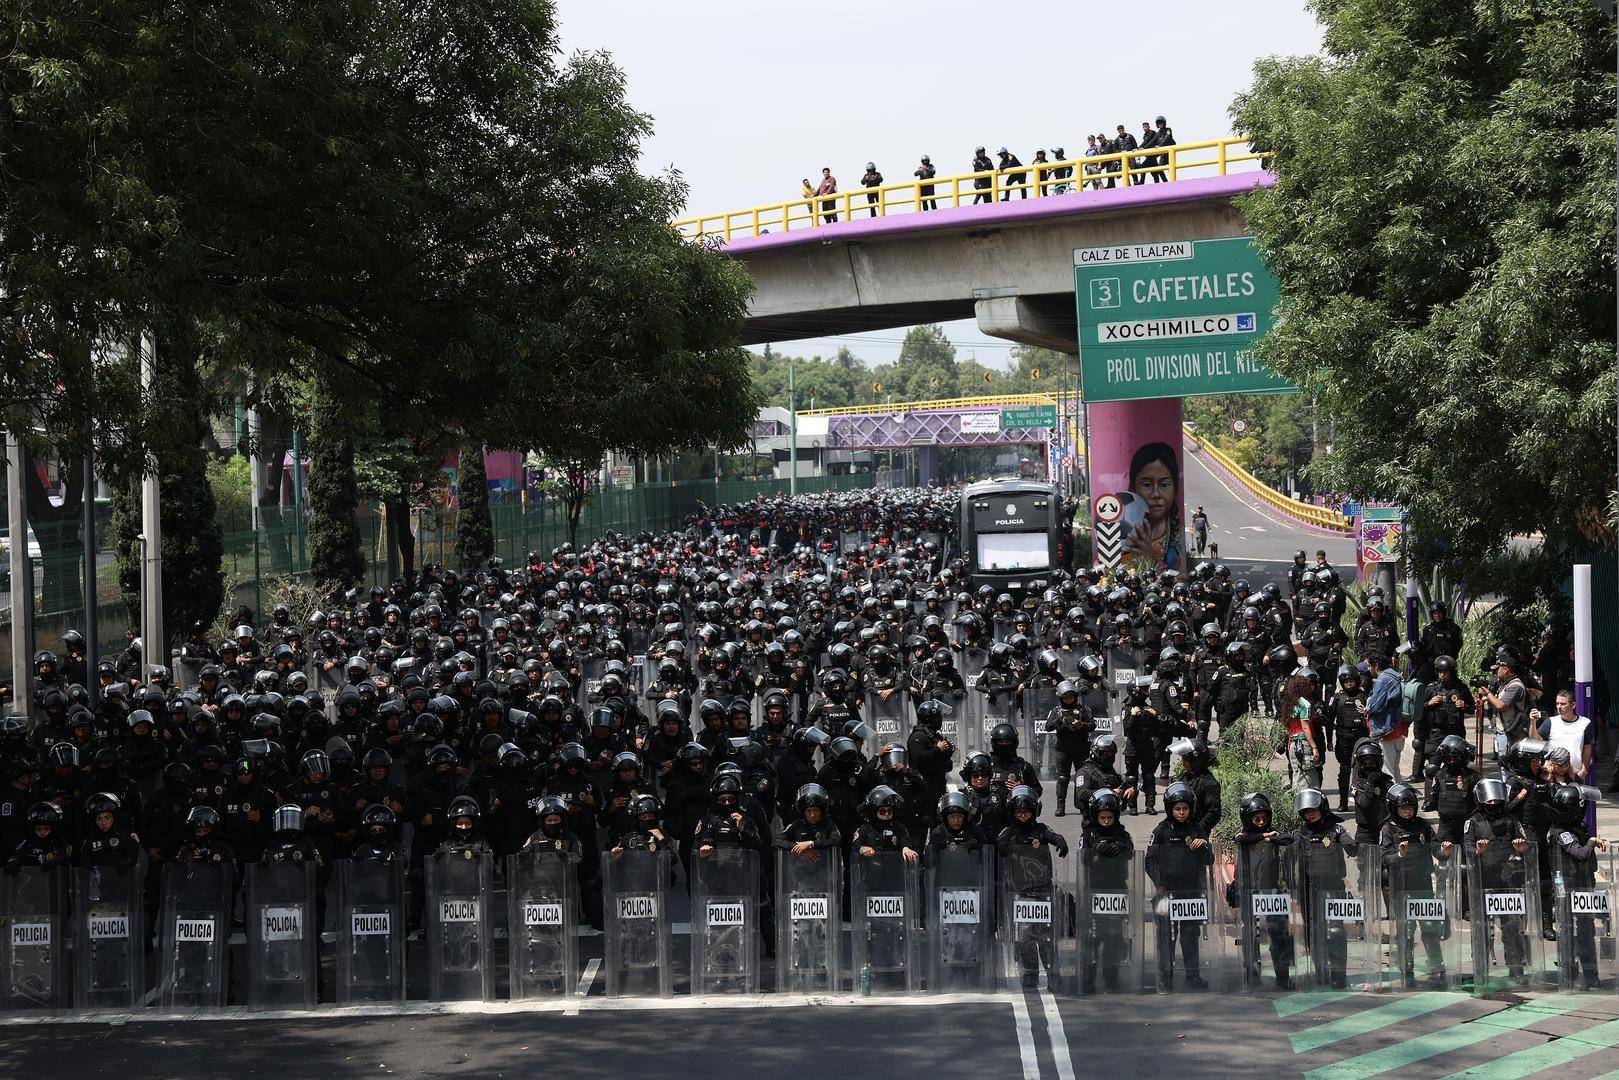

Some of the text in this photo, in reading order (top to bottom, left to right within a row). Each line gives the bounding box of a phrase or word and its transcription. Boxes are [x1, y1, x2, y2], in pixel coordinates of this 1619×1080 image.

[1081, 244, 1184, 262] CALZ DE TLALPAN
[1099, 285, 1112, 301] 3
[1132, 271, 1256, 304] CAFETALES
[1106, 318, 1230, 340] XOCHIMILCO
[1106, 358, 1140, 383] PROL
[1146, 353, 1201, 381] DIVISION
[1206, 350, 1231, 376] DEL
[621, 900, 652, 916] POLICIA
[792, 902, 824, 916] POLICIA
[868, 899, 902, 914] POLICIA
[943, 900, 975, 915] POLICIA
[1093, 896, 1127, 912] POLICIA
[1171, 902, 1205, 918] POLICIA
[1255, 897, 1289, 913] POLICIA
[1327, 902, 1362, 917] POLICIA
[1409, 902, 1443, 916] POLICIA
[1488, 897, 1522, 911] POLICIA
[1573, 895, 1608, 910] POLICIA
[444, 904, 475, 919] POLICIA
[526, 908, 560, 922] POLICIA
[709, 907, 742, 922] POLICIA
[1016, 904, 1049, 920] POLICIA
[92, 920, 126, 935] POLICIA
[178, 923, 212, 938] POLICIA
[266, 915, 298, 932] POLICIA
[354, 917, 388, 931] POLICIA
[14, 927, 48, 942] POLICIA
